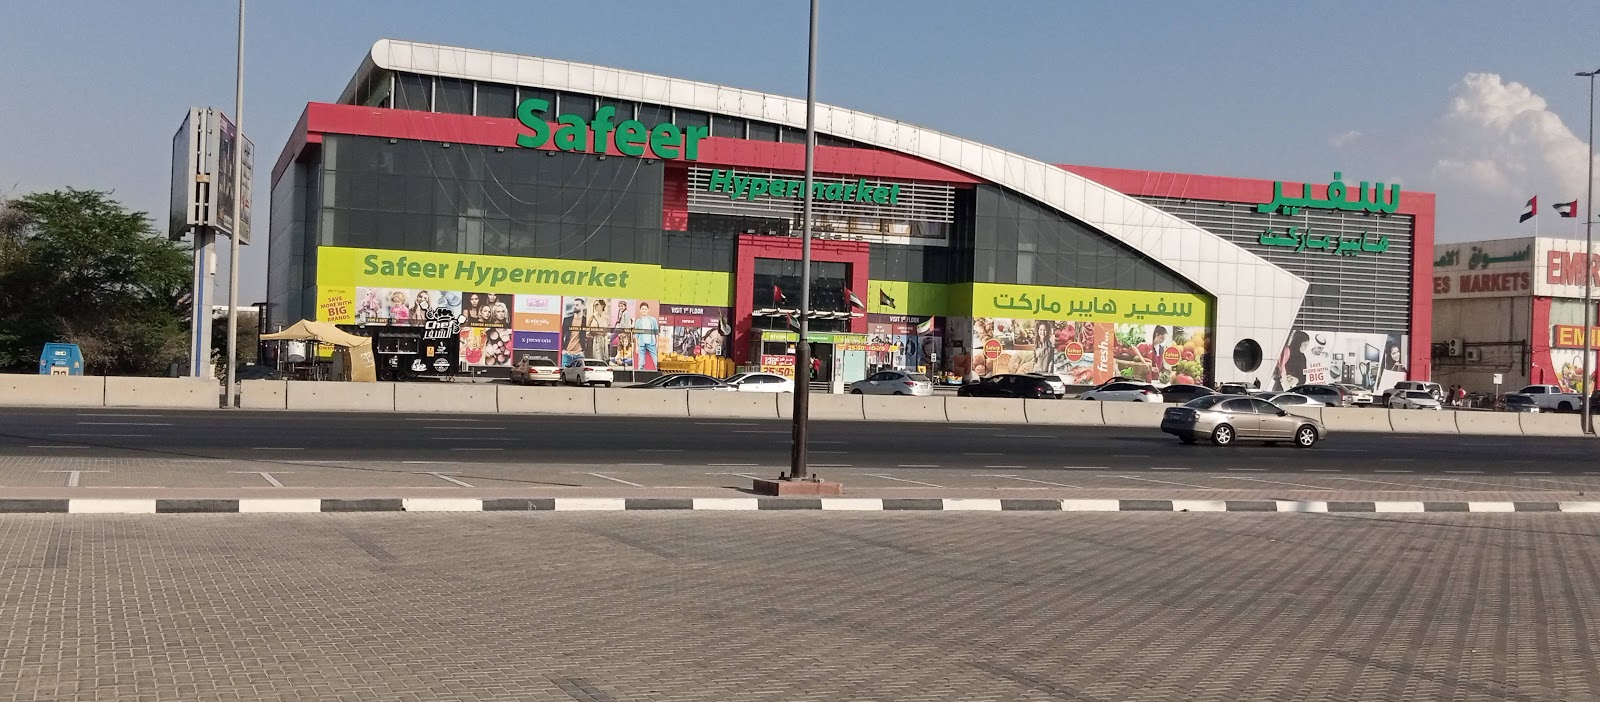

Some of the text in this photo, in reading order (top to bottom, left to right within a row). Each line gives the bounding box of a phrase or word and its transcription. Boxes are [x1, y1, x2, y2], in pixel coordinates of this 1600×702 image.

[516, 98, 708, 161] Safeer
[708, 168, 902, 206] Hypermarket
[1257, 171, 1400, 216] سفير
[1258, 226, 1390, 256] هايبر ماركت
[363, 254, 629, 288] Safeer Hypermarket
[1459, 271, 1530, 293] MARKETS
[327, 314, 350, 322] BRANDS
[328, 306, 347, 316] BIG
[671, 306, 683, 314] VISIT
[690, 307, 704, 315] FLOOR
[993, 293, 1193, 320] سفير هايبر ماركت
[1309, 372, 1324, 381] BIG
